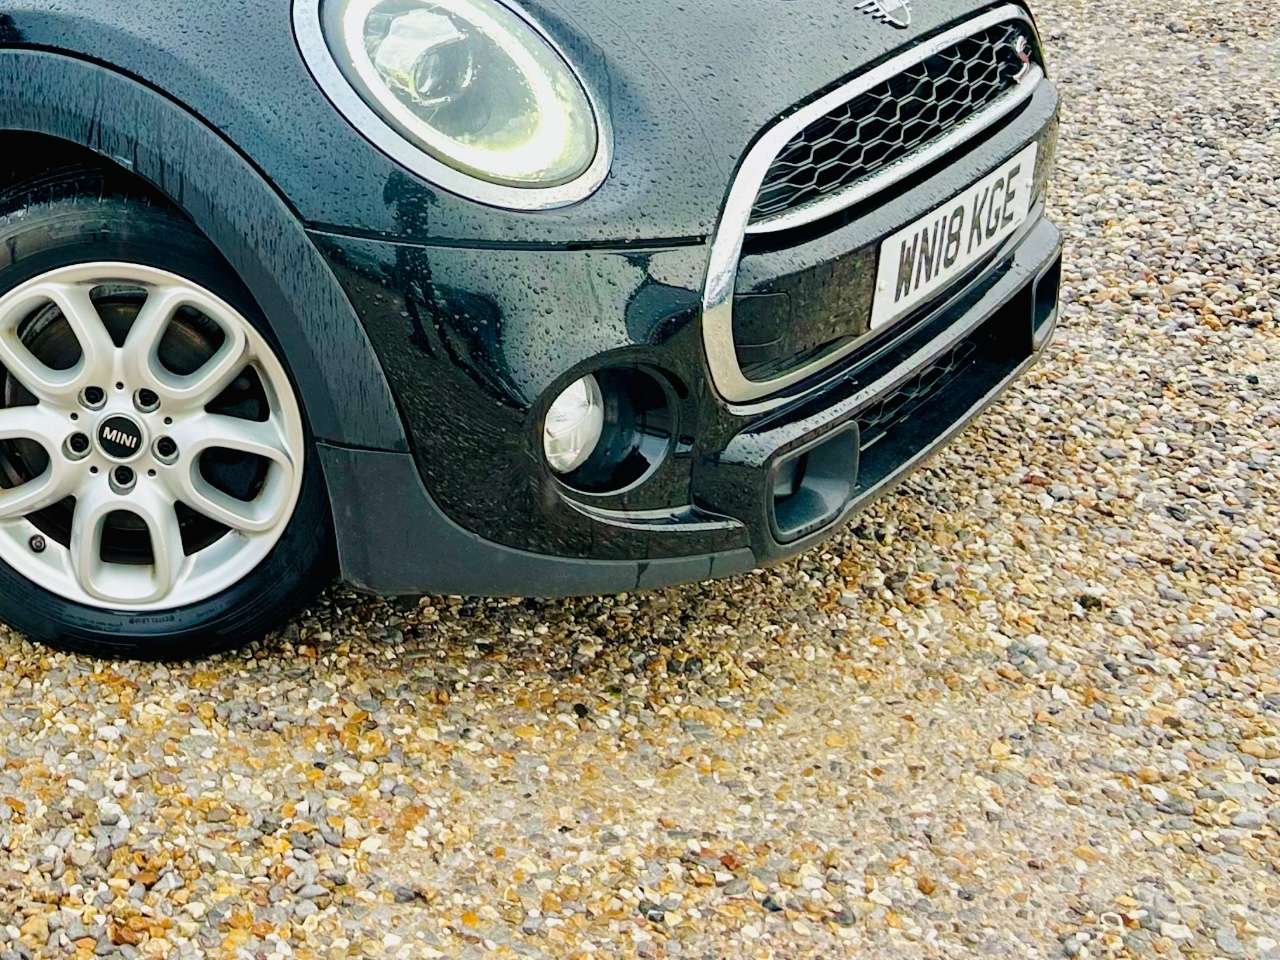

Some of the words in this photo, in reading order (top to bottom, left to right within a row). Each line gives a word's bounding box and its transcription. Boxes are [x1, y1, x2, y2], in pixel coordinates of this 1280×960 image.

[894, 204, 965, 303] WN18
[966, 163, 1021, 255] KGE
[103, 426, 137, 448] MINI
